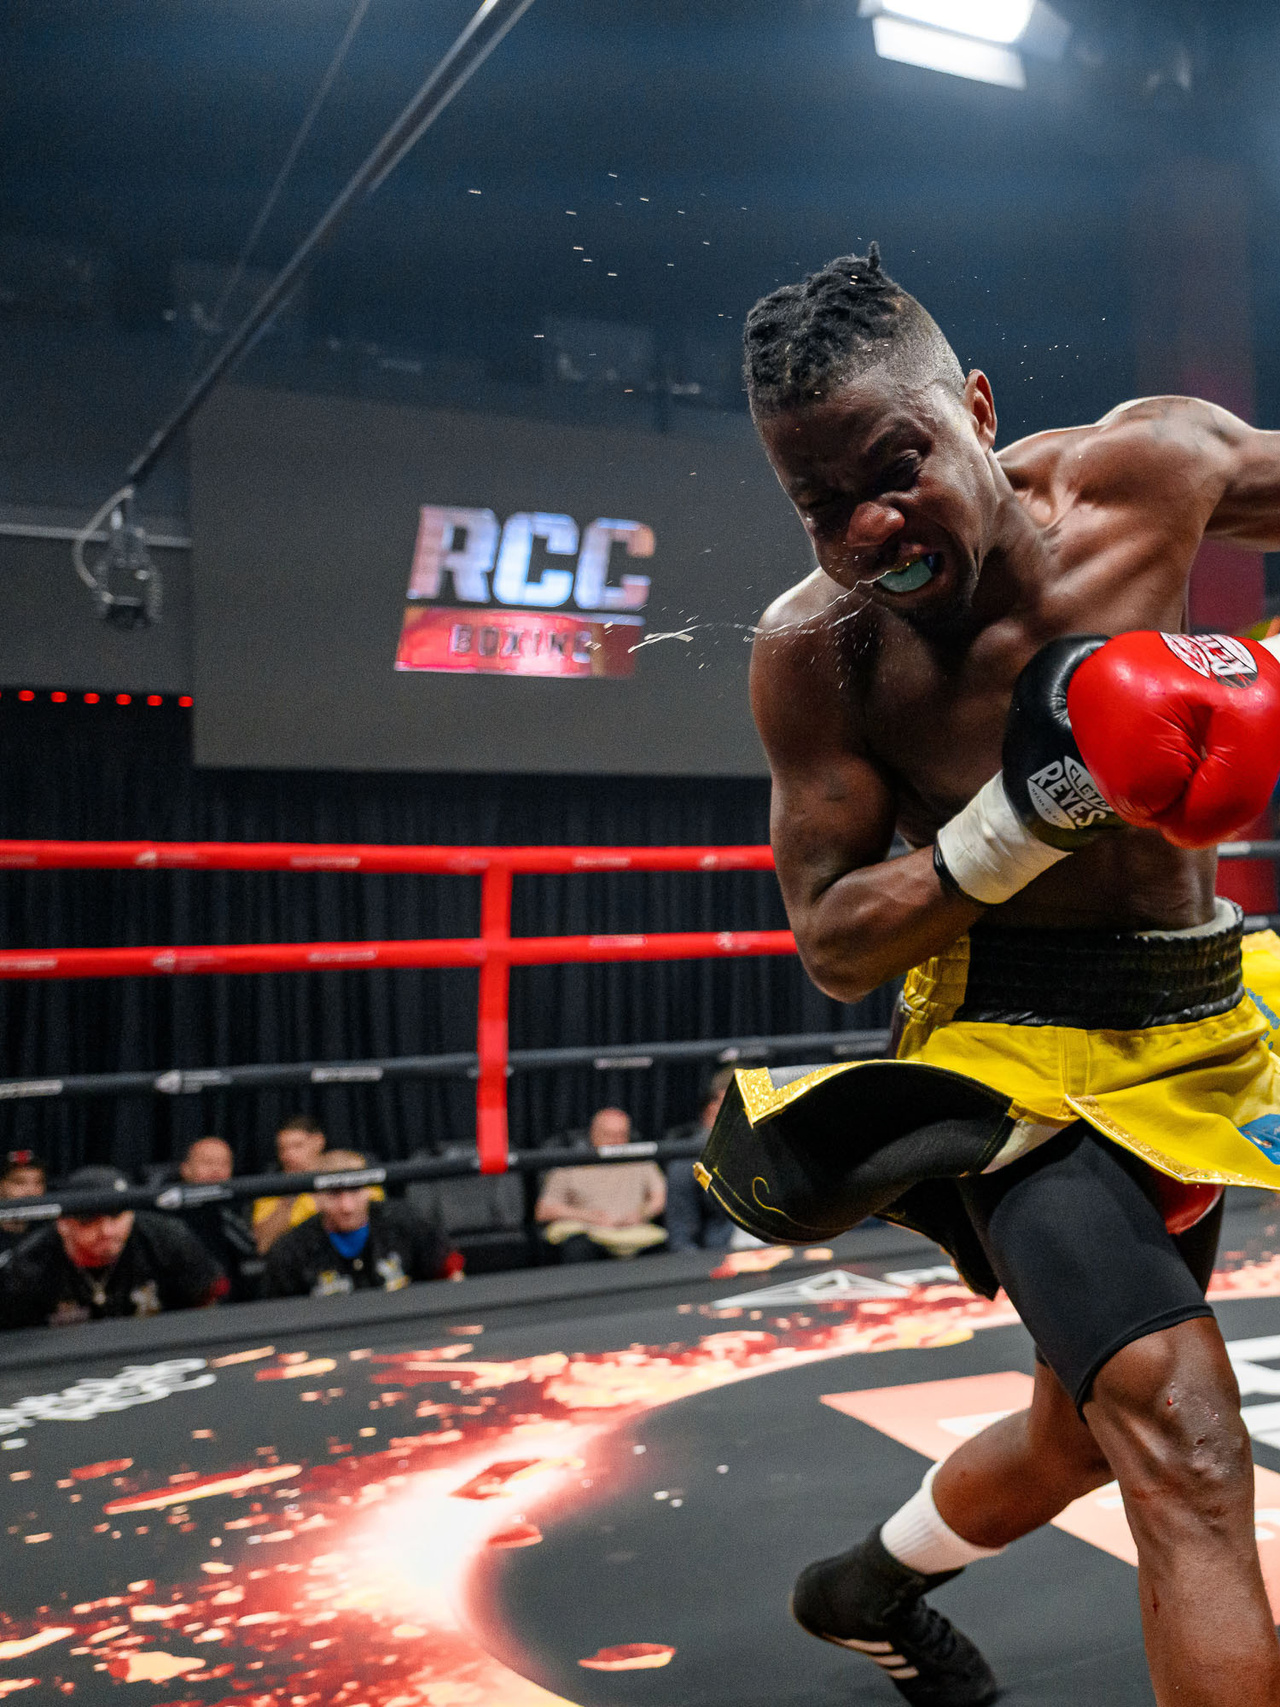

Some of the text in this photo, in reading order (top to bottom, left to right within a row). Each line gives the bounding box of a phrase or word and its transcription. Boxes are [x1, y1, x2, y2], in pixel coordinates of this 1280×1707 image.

[407, 504, 656, 611] RCC
[1028, 760, 1107, 828] REYES
[1068, 763, 1109, 808] CLETO
